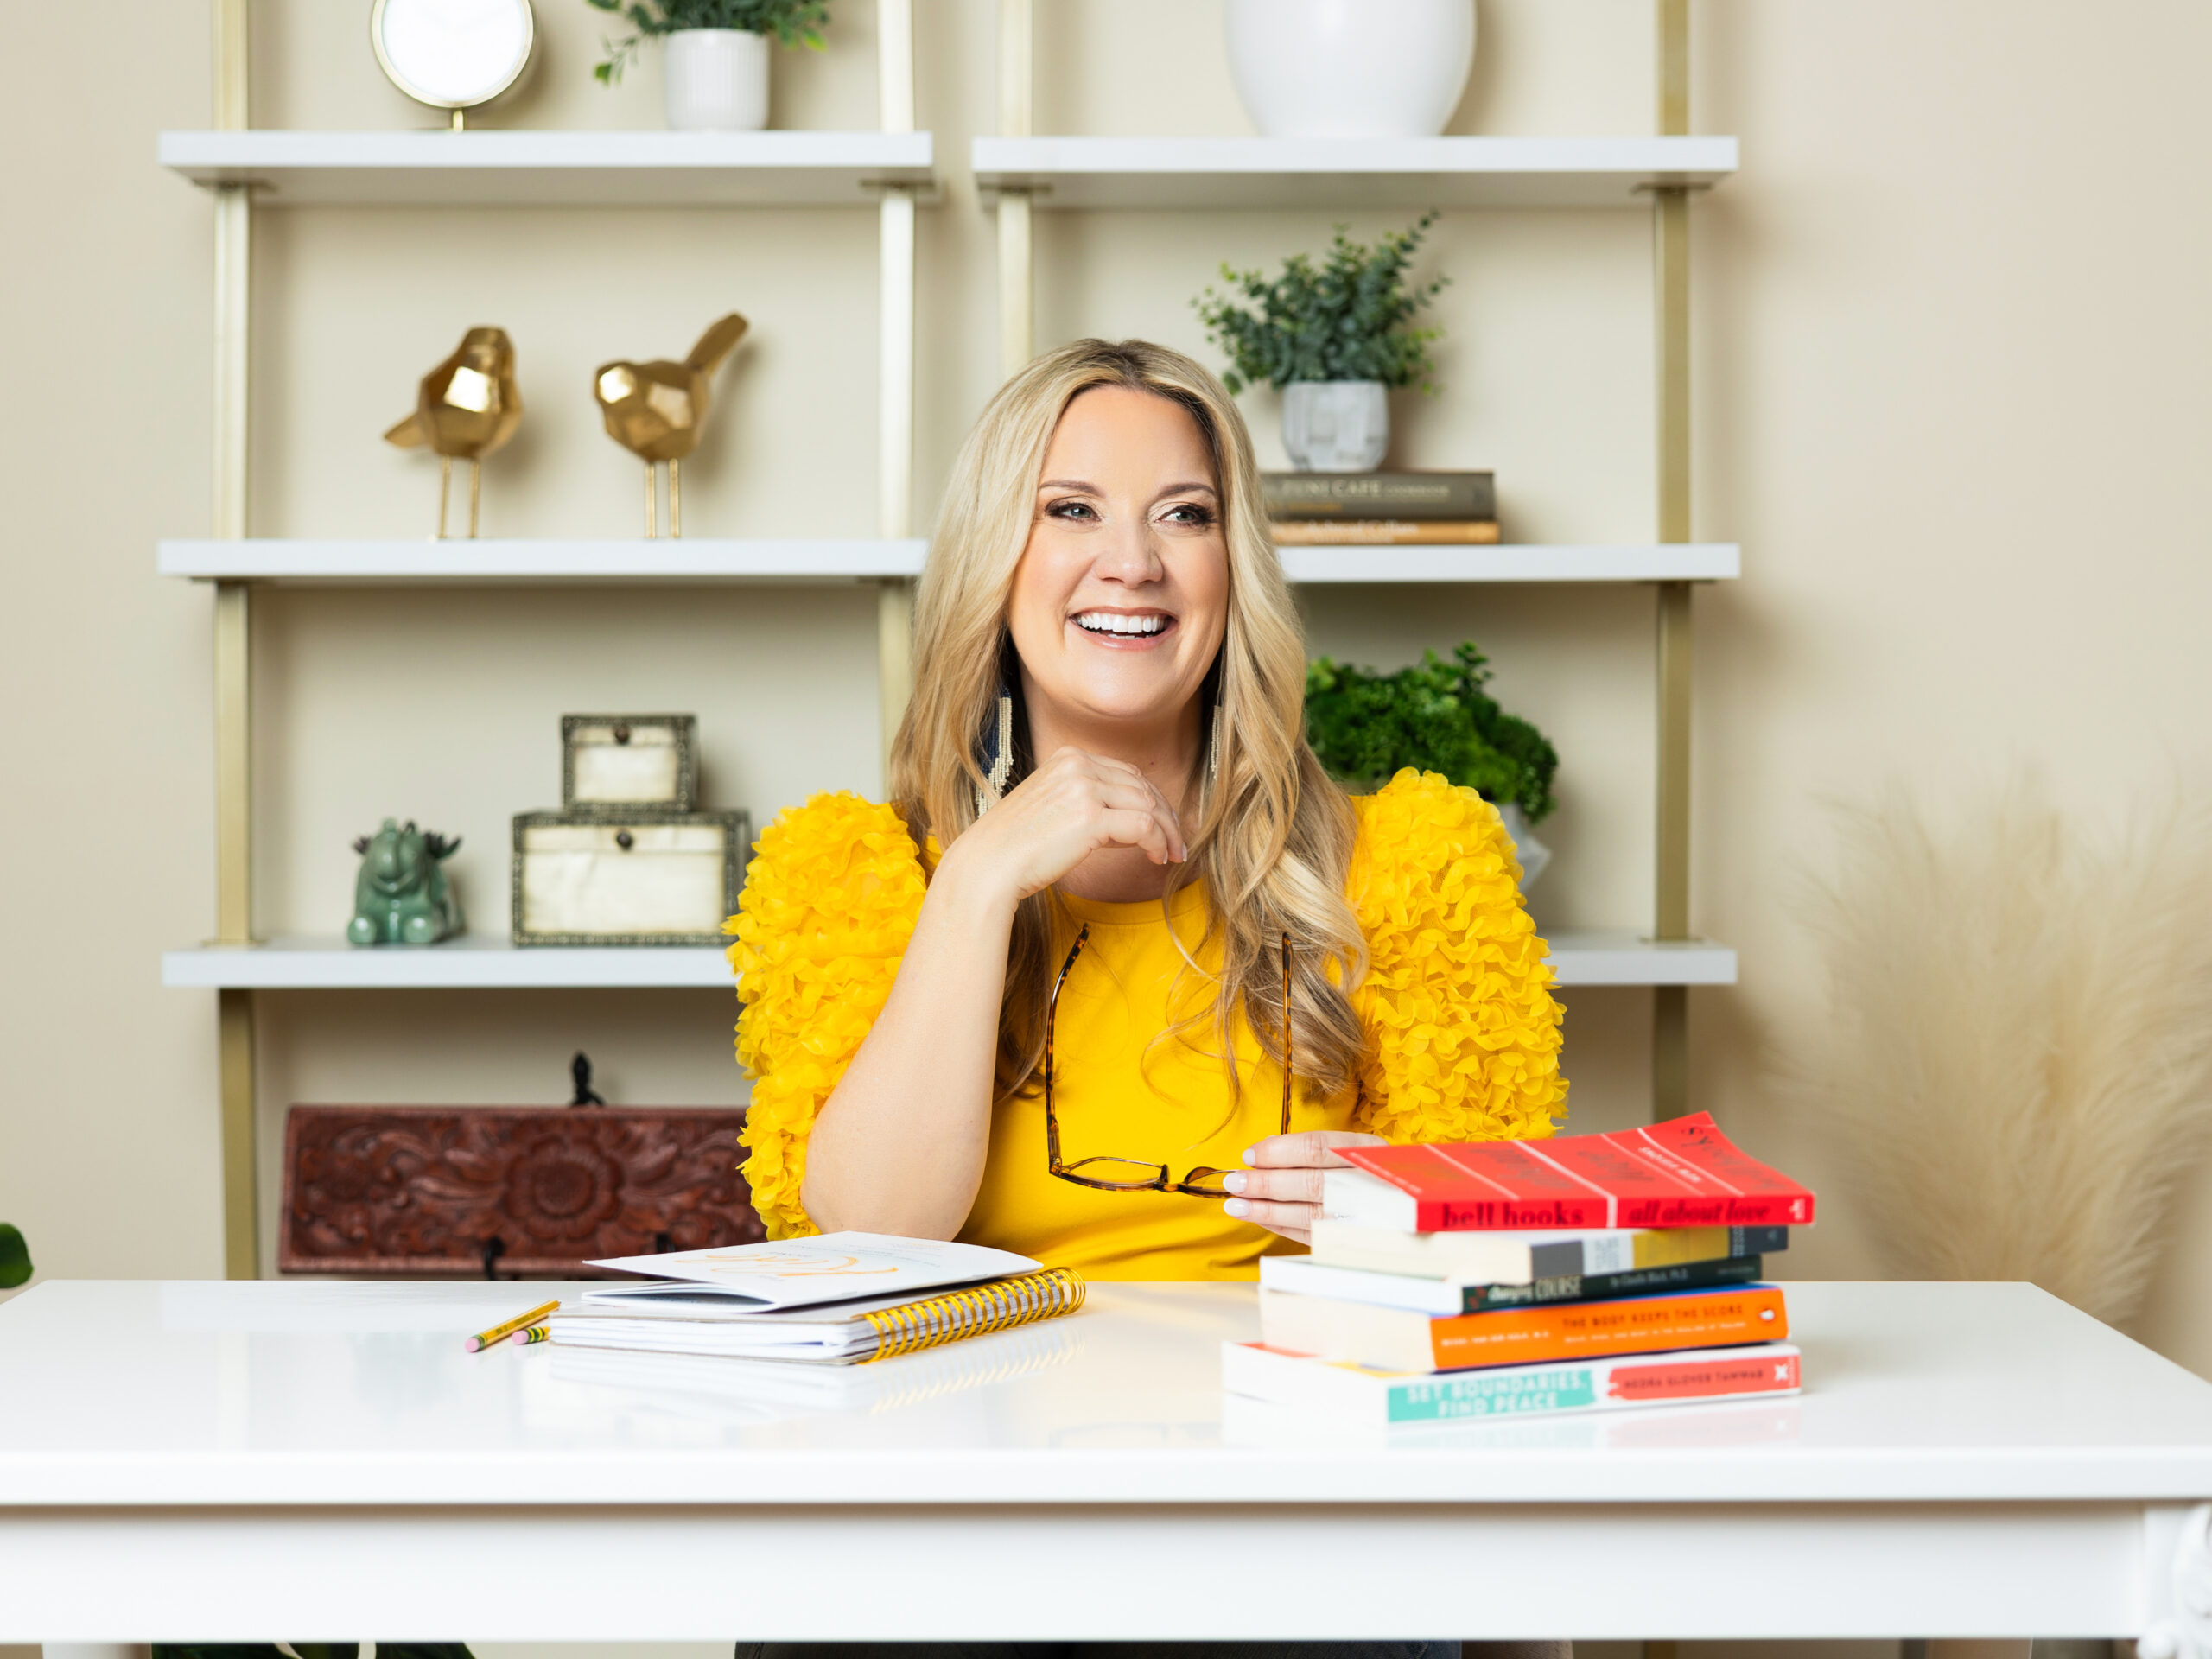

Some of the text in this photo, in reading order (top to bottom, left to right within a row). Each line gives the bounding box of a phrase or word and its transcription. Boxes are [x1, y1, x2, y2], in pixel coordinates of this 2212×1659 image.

[1442, 1200, 1584, 1228] bell hooks
[1629, 1200, 1661, 1224] all
[1662, 1199, 1723, 1223] about
[1726, 1198, 1770, 1220] love
[1535, 1275, 1583, 1300] COURSE
[1703, 1305, 1742, 1317] SCORE
[1407, 1382, 1444, 1404] SET
[1438, 1391, 1557, 1418] FIND PEACE
